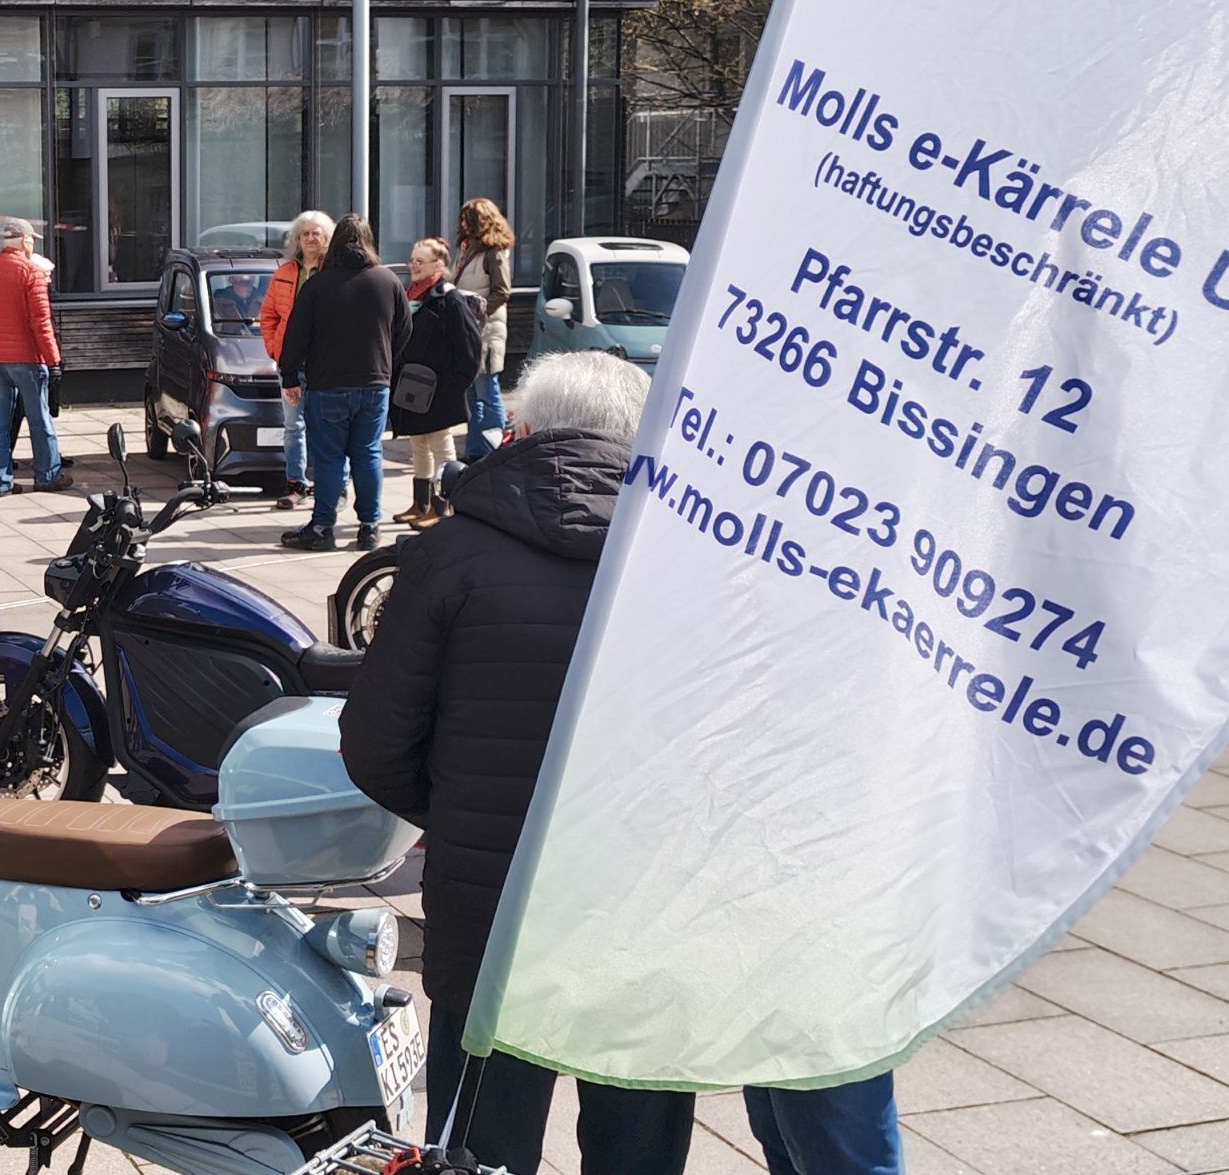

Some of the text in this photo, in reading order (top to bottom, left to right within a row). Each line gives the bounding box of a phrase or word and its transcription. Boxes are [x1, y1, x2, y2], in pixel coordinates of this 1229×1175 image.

[776, 59, 900, 153] Molls
[907, 131, 1182, 279] e-Kärrele
[813, 152, 1179, 346] (haftungsbeschränkt)
[716, 284, 1136, 541] 73266 Bissingen
[790, 247, 1094, 435] Pfarrstr. 12
[741, 440, 902, 548] 07023
[910, 529, 1108, 671] 909274
[380, 1021, 400, 1060] ES
